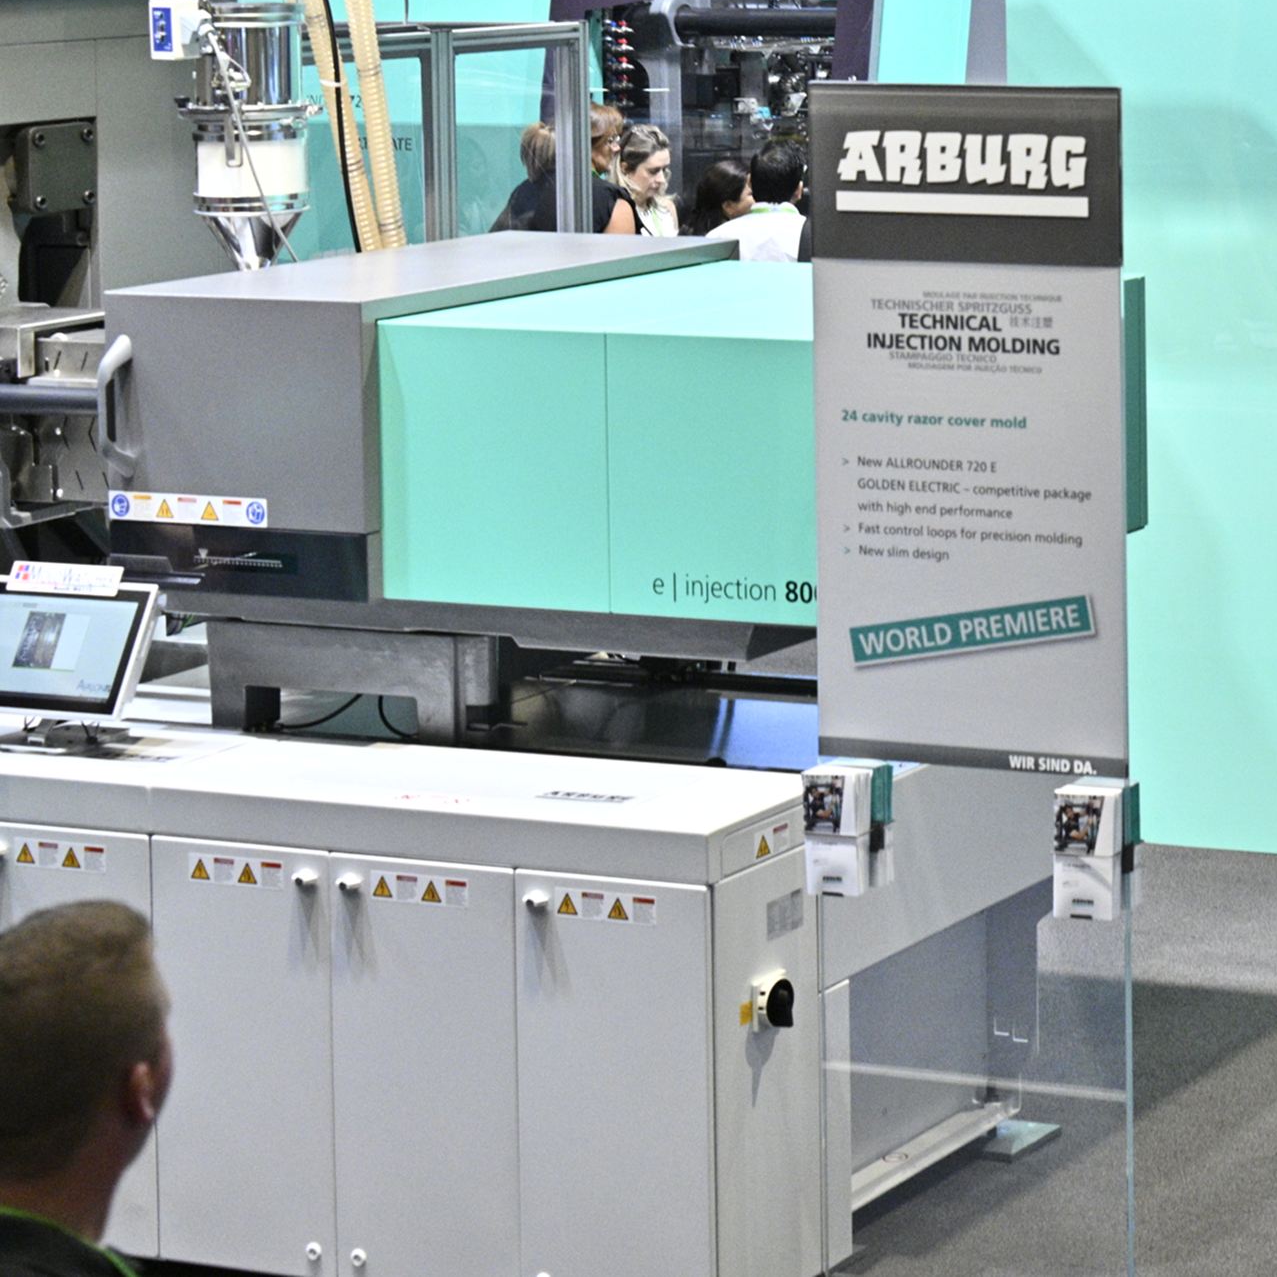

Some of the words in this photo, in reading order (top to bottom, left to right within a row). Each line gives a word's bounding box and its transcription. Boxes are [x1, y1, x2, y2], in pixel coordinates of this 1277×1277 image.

[837, 130, 1087, 190] ARBURG
[871, 298, 954, 312] TECHNISCHER
[957, 300, 1032, 315] SPRITZGUSS
[898, 312, 1002, 332] TECHNICAL
[867, 332, 962, 351] INJECTION
[968, 336, 1060, 355] MOLDING
[841, 409, 858, 422] 24
[862, 410, 902, 426] cavity
[907, 413, 943, 425] razor
[947, 415, 986, 428] cover
[990, 415, 1027, 429] mold
[857, 456, 882, 469] New
[886, 456, 963, 472] ALLROUNDER
[967, 460, 987, 473] 720
[990, 461, 997, 473] E
[857, 477, 905, 492] GOLDEN
[908, 479, 961, 494] ELECTRIC
[972, 483, 1040, 500] competitive
[1043, 487, 1092, 502] package
[857, 500, 883, 514] with
[886, 500, 910, 517] high
[913, 502, 936, 515] end
[939, 505, 1013, 521] performance
[858, 523, 880, 536] Fast
[883, 524, 923, 538] control
[926, 526, 958, 541] loops
[960, 527, 977, 539] for
[980, 529, 1031, 545] precision
[1035, 531, 1083, 548] molding
[858, 545, 884, 558] New
[887, 545, 909, 559] slim
[912, 547, 950, 563] design
[653, 577, 664, 595] e
[685, 573, 776, 604] injection
[785, 580, 817, 604] 80
[858, 622, 953, 656] WORLD
[959, 603, 1081, 643] PREMIERE
[1008, 754, 1035, 771] WIR
[1038, 755, 1070, 774] SIND
[1073, 758, 1097, 776] DA.
